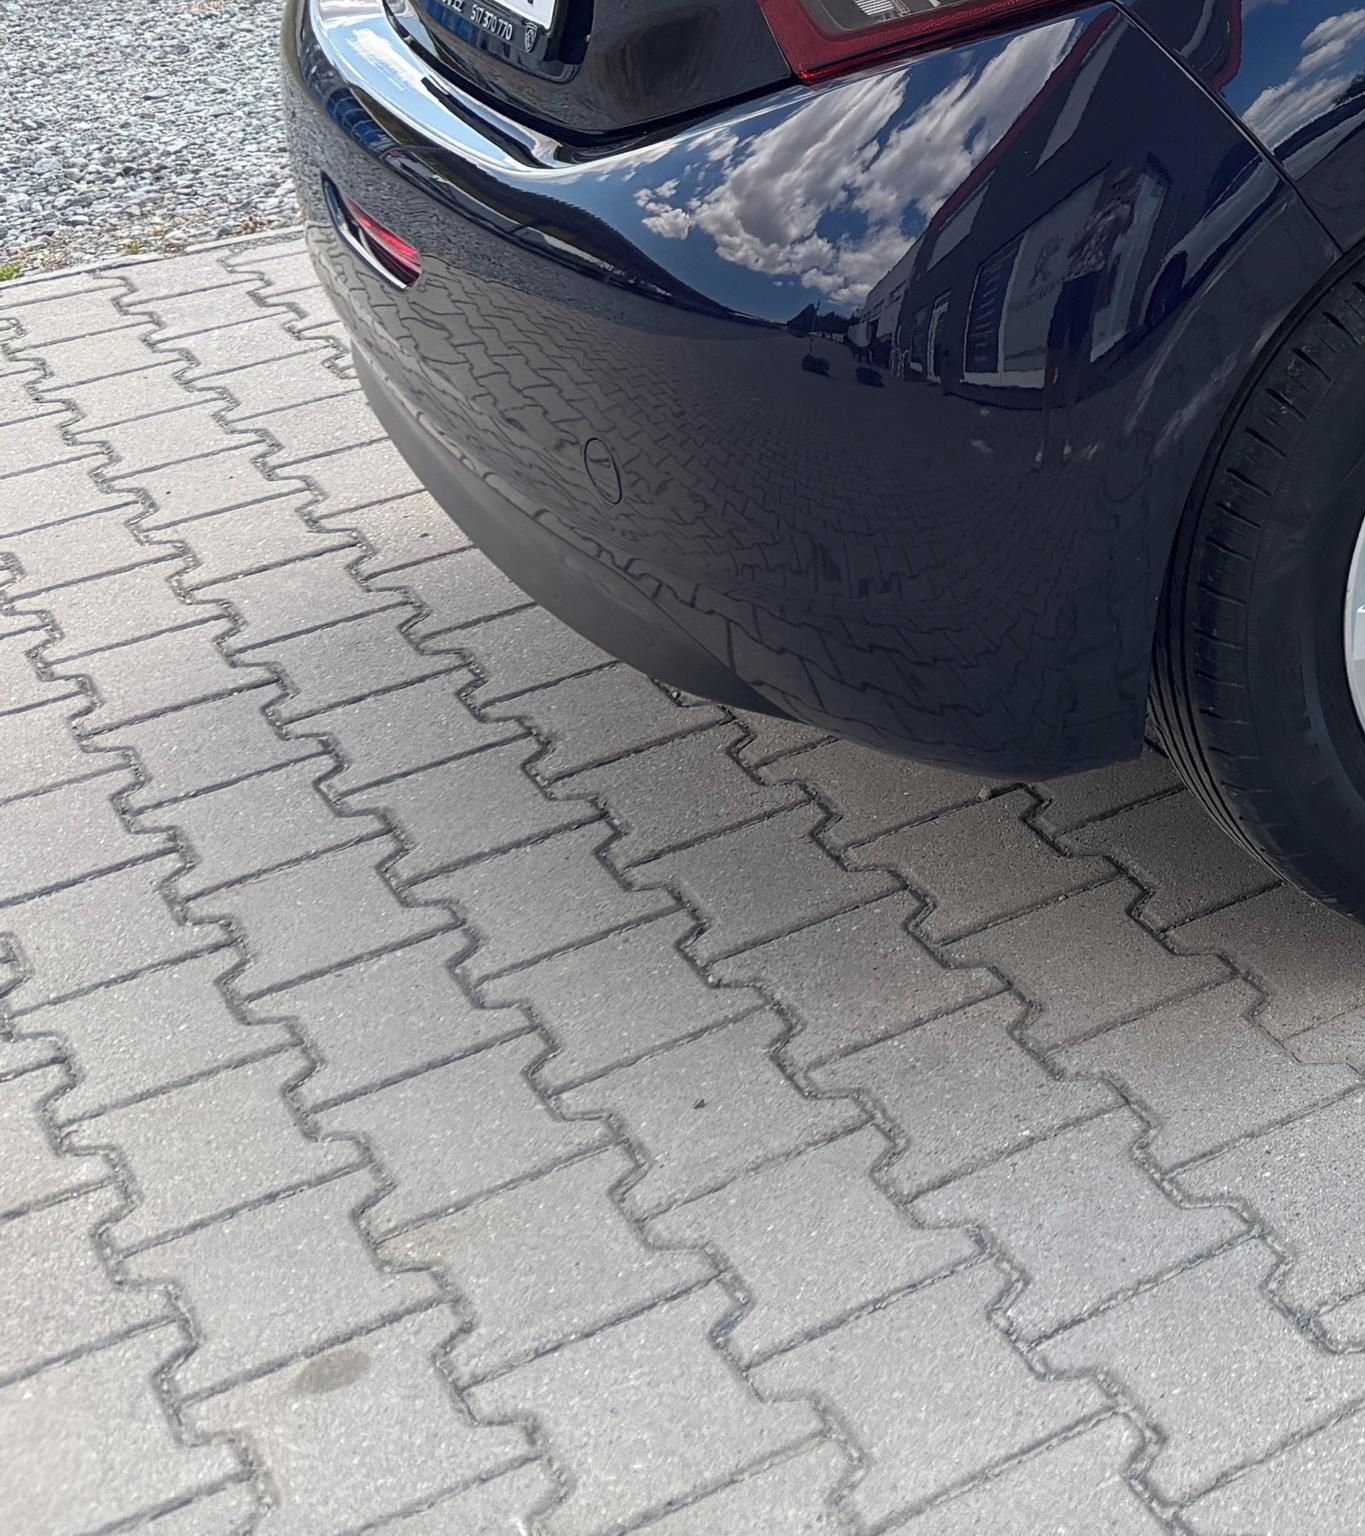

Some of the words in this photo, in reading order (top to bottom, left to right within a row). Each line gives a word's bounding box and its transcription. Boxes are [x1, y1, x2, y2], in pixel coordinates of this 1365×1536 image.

[470, 4, 484, 25] 517
[482, 10, 497, 33] 370
[496, 18, 513, 41] 770
